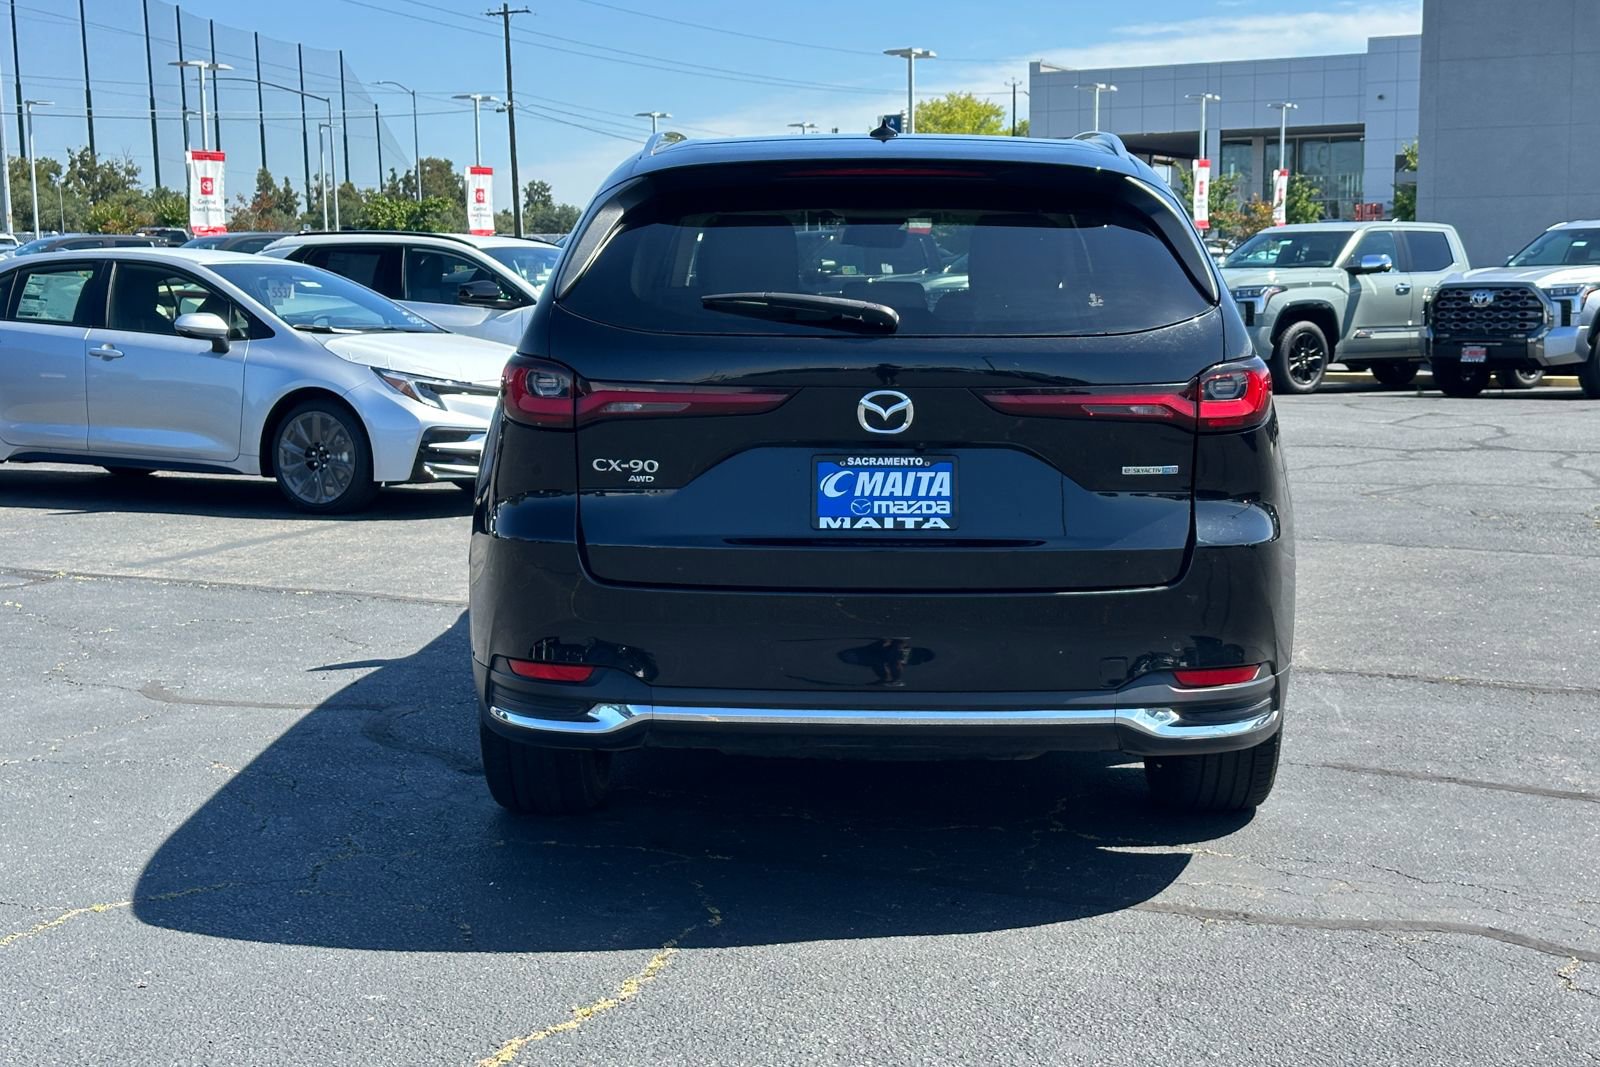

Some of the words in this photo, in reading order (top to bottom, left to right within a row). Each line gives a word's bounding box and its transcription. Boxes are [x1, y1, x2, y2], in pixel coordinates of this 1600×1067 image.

[592, 458, 659, 473] CX-90
[847, 457, 923, 466] SACRAMENTO
[628, 475, 655, 483] AWD
[873, 500, 951, 514] mazda
[819, 516, 951, 529] MAITA
